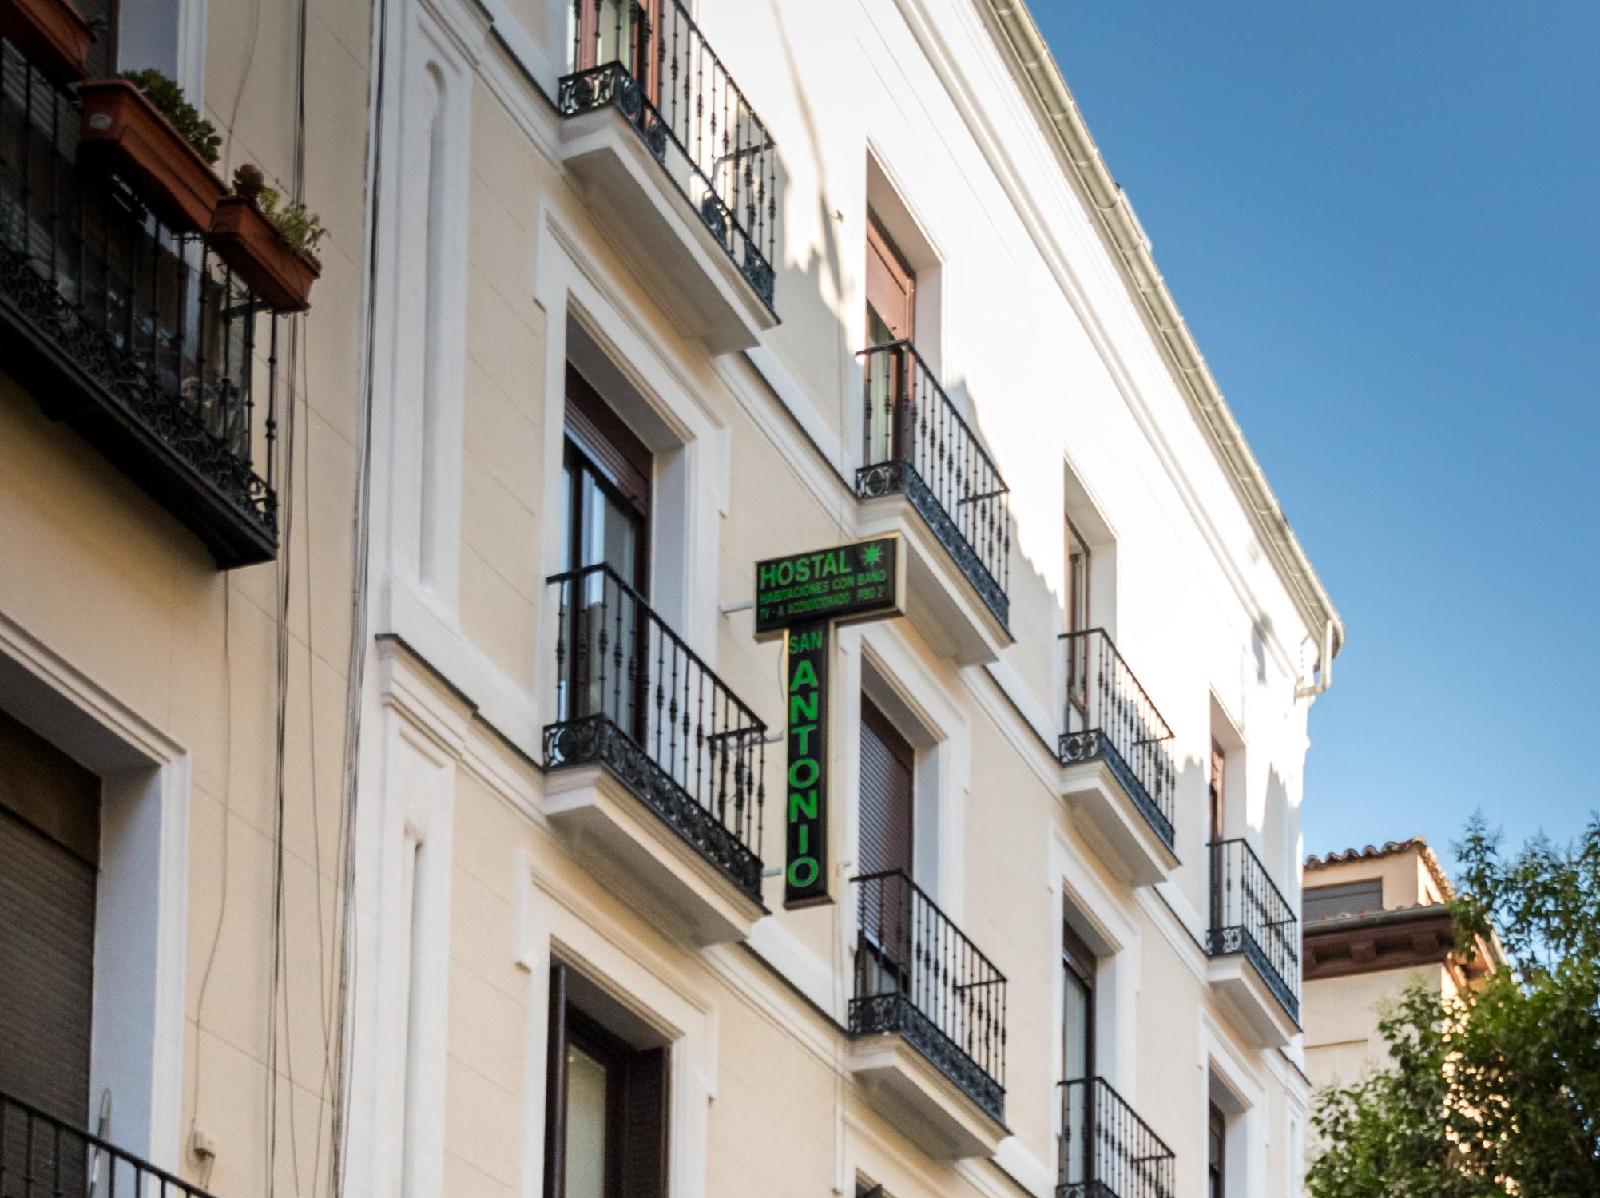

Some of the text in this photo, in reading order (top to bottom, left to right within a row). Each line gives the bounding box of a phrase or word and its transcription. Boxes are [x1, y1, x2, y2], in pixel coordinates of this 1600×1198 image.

[760, 551, 851, 590] HOSTAL
[832, 576, 854, 590] CON
[789, 631, 822, 654] SAN
[788, 659, 820, 888] ANTONIO
